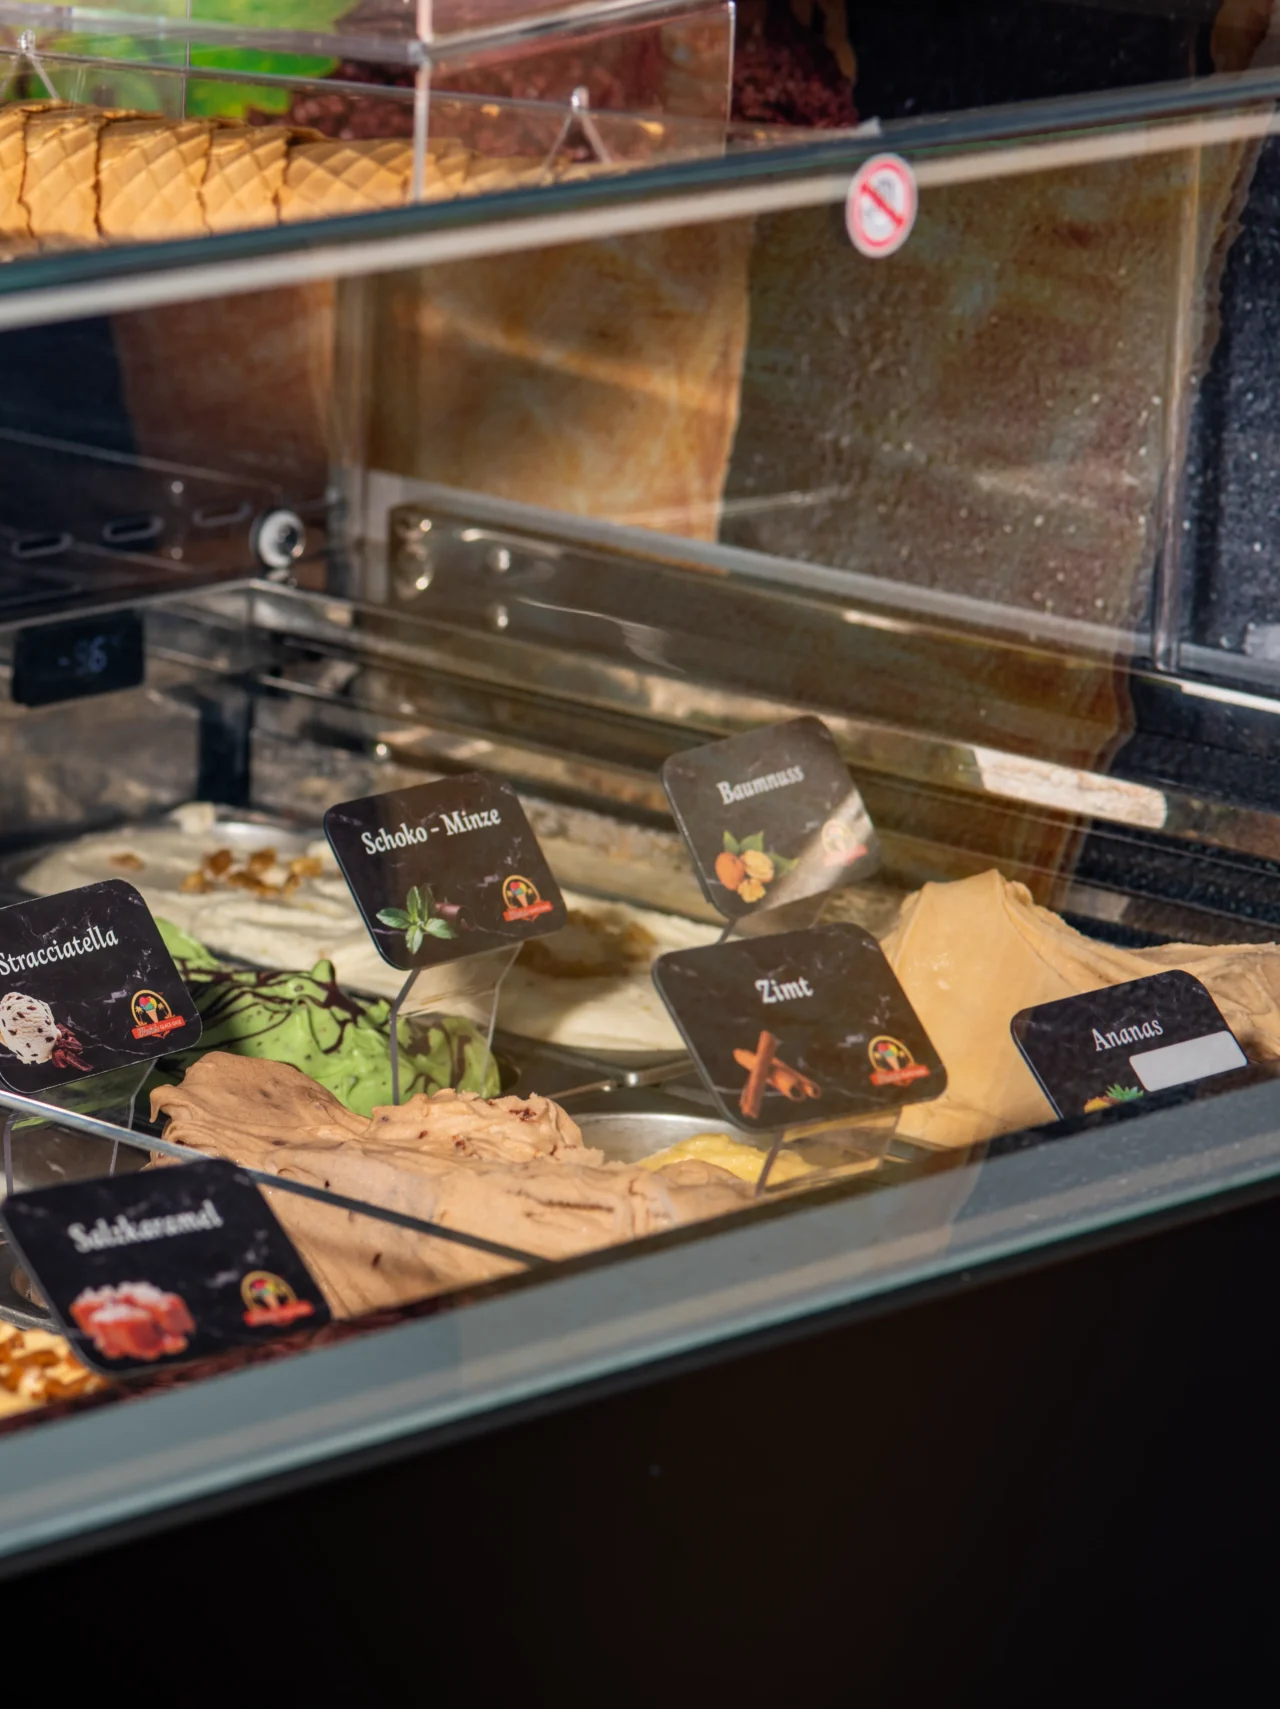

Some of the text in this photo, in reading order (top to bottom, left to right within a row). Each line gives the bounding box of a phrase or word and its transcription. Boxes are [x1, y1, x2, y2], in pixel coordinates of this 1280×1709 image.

[716, 764, 805, 805] Baumnuss
[361, 822, 428, 855] Schoko
[439, 808, 502, 836] Minze
[754, 976, 814, 1004] Zimt
[1091, 1019, 1164, 1052] Ananas
[68, 1199, 224, 1253] Salzkaramel
